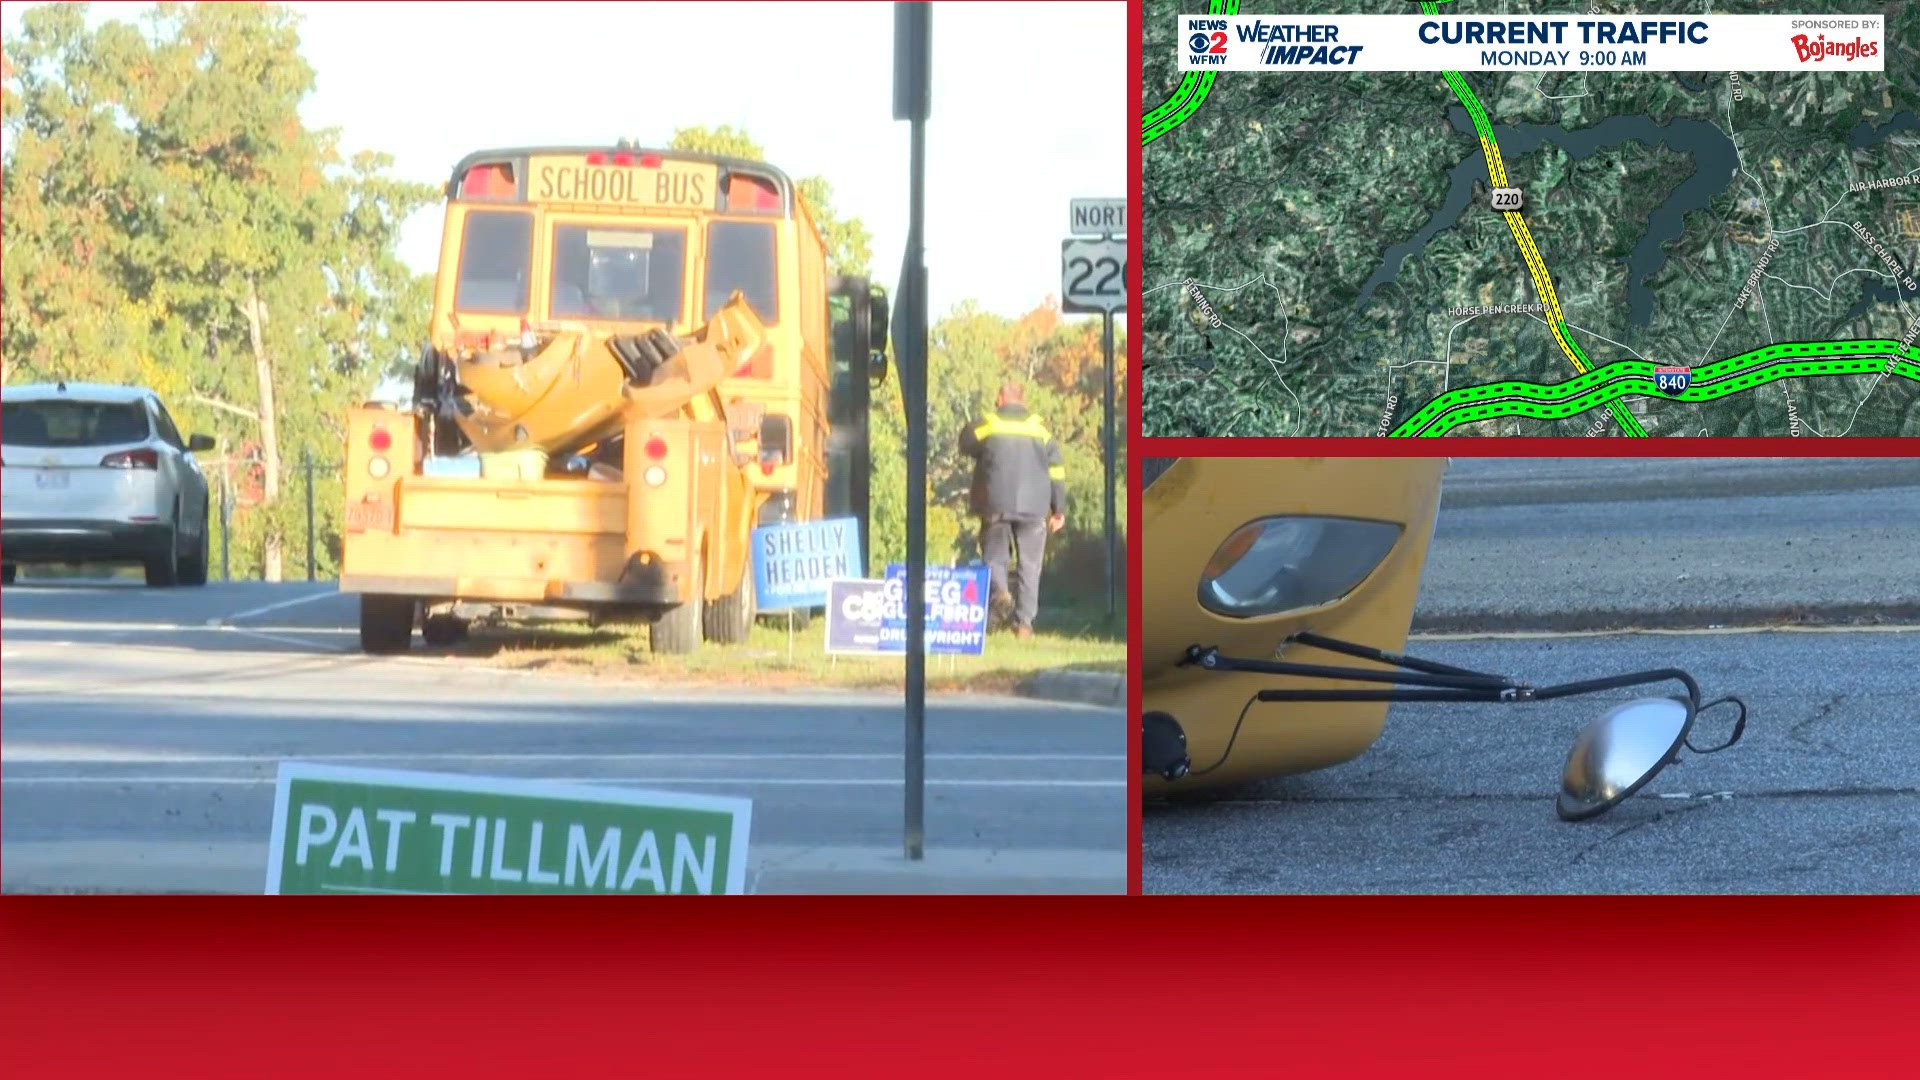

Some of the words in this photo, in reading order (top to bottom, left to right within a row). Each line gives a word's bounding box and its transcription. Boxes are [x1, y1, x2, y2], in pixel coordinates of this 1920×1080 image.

[540, 166, 638, 202] SCHOOL
[655, 171, 704, 205] BUS
[1068, 256, 1127, 296] 22
[764, 523, 844, 556] SHELLY
[765, 553, 848, 585] HEADEN
[883, 577, 961, 607] GEG
[296, 804, 416, 872] PAT
[430, 813, 717, 895] TILLMAN
